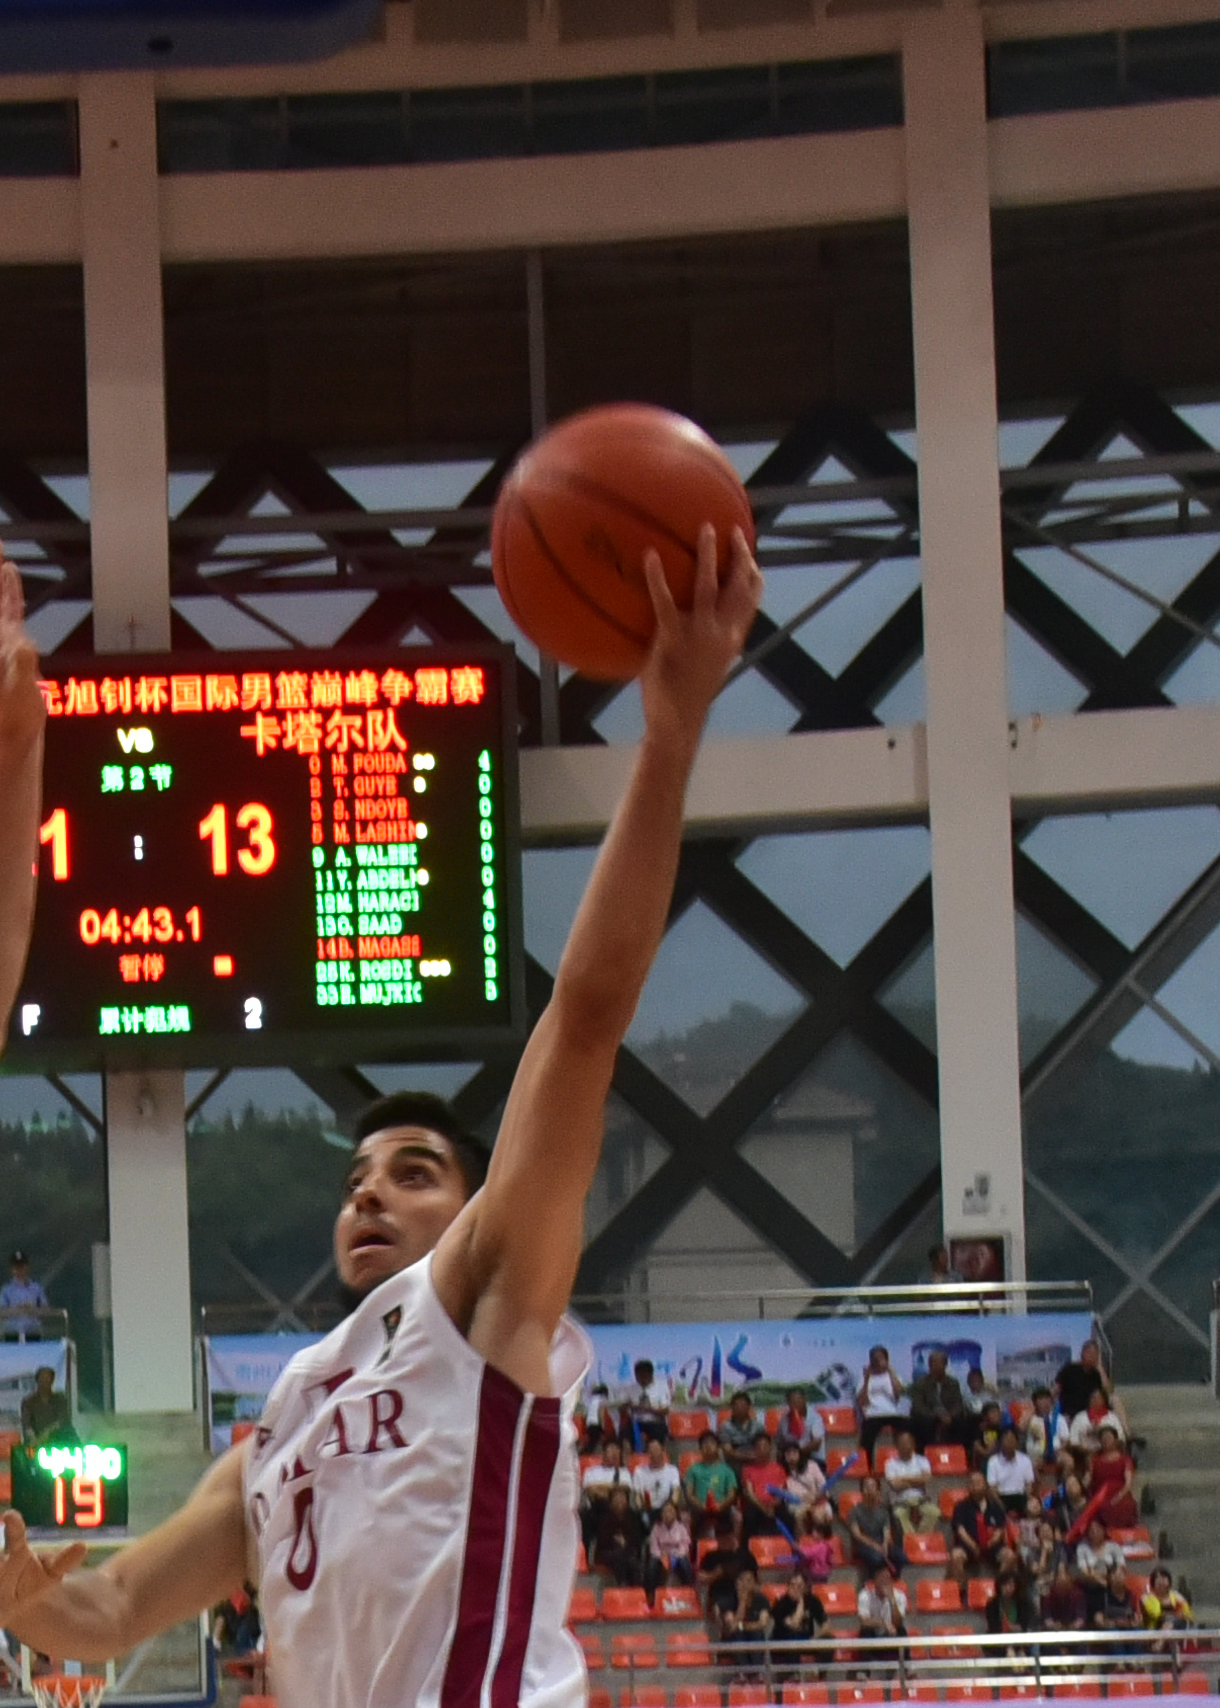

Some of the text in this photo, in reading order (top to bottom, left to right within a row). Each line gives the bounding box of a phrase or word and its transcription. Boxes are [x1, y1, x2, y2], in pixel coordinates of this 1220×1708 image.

[117, 727, 154, 754] VS
[240, 707, 408, 757] 卡塔尔队
[479, 774, 491, 794] 0
[480, 797, 492, 818] 0
[32, 802, 275, 881] 1 13
[480, 820, 492, 840] 0
[481, 841, 493, 863] 0
[315, 870, 334, 891] 11
[481, 865, 494, 887] 0
[80, 905, 202, 945] 04:43.1
[483, 910, 495, 932] 0
[483, 934, 496, 955] 0
[244, 997, 262, 1029] 2
[55, 1476, 103, 1527] 19
